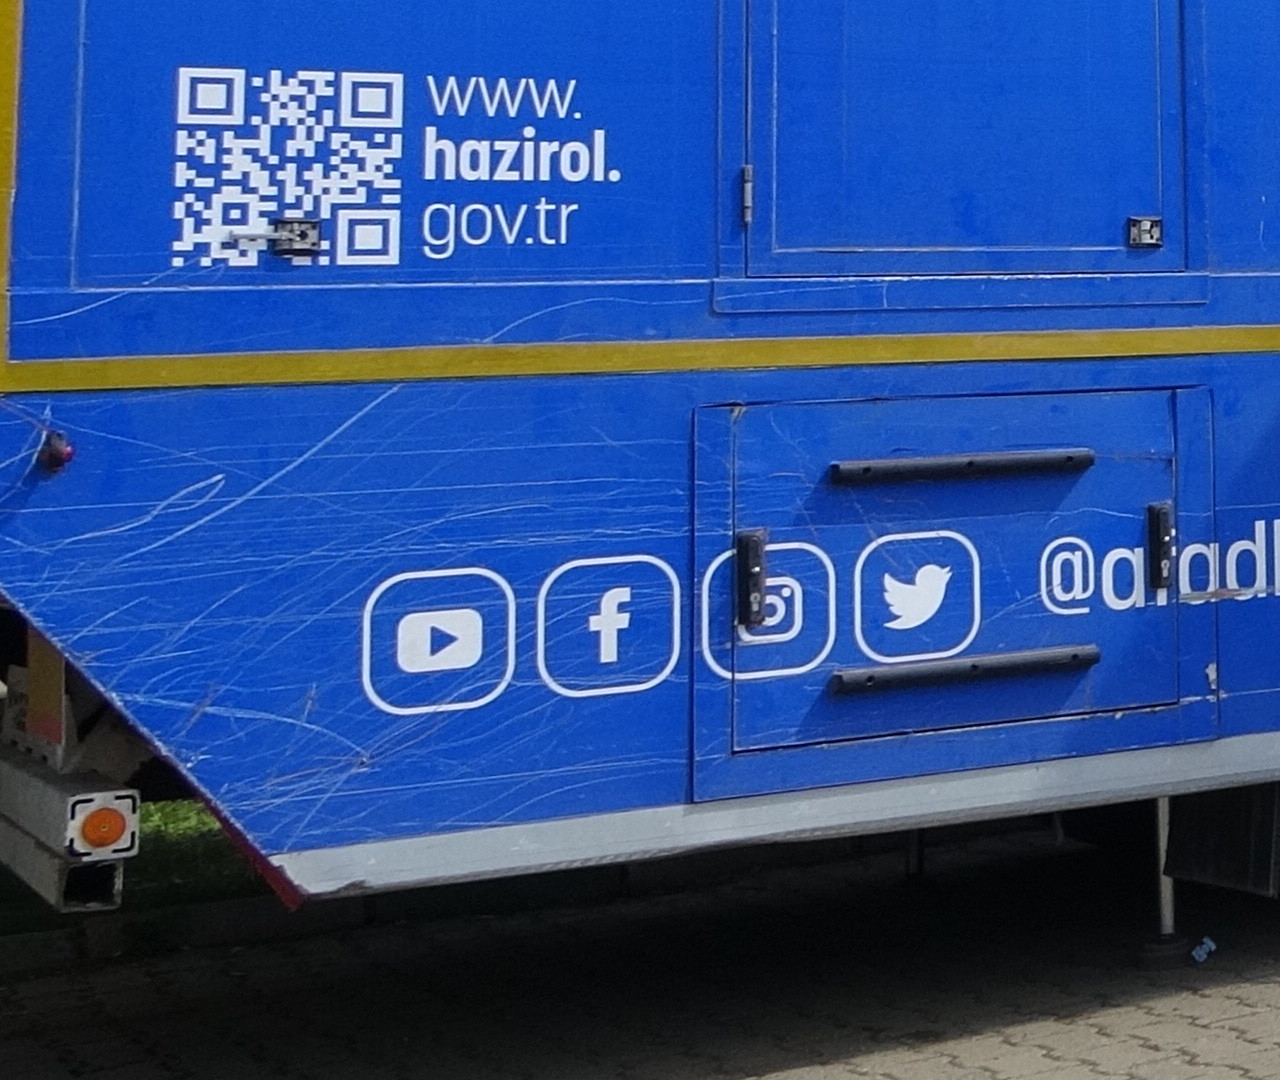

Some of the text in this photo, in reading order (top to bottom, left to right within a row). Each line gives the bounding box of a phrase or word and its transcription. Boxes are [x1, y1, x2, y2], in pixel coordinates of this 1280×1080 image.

[427, 75, 582, 119] www.
[423, 125, 622, 182] hazirol.
[421, 197, 580, 259] gov.tr
